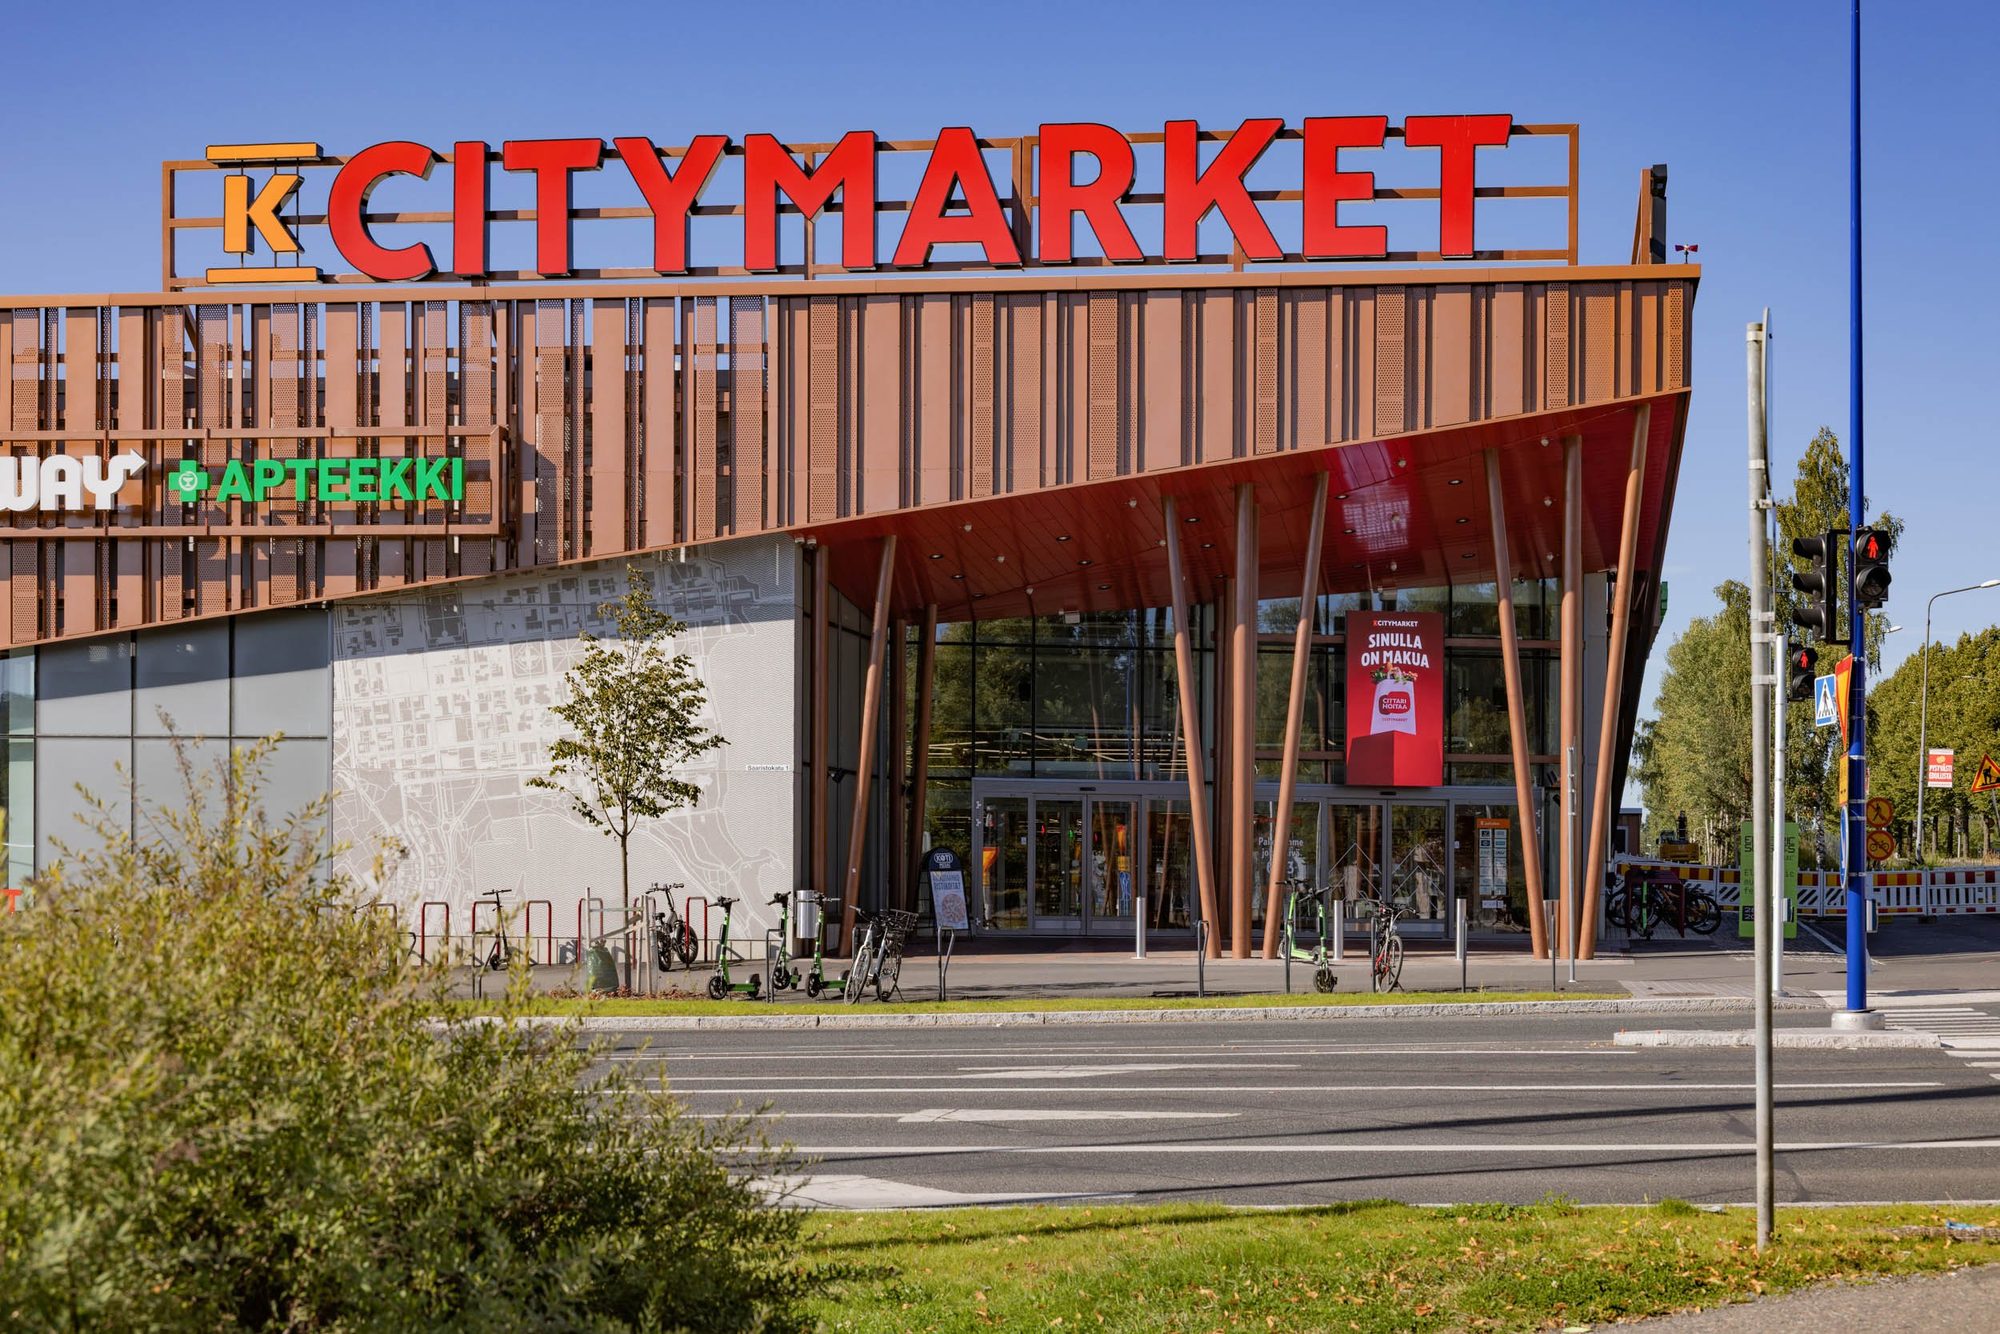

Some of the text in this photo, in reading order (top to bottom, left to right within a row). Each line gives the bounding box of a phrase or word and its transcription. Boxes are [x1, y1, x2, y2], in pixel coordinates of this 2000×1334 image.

[328, 114, 1512, 281] CITYMARKET
[216, 457, 466, 502] APTEEKKI
[1368, 632, 1423, 649] SINULLA
[1361, 650, 1430, 668] ON MAKUA
